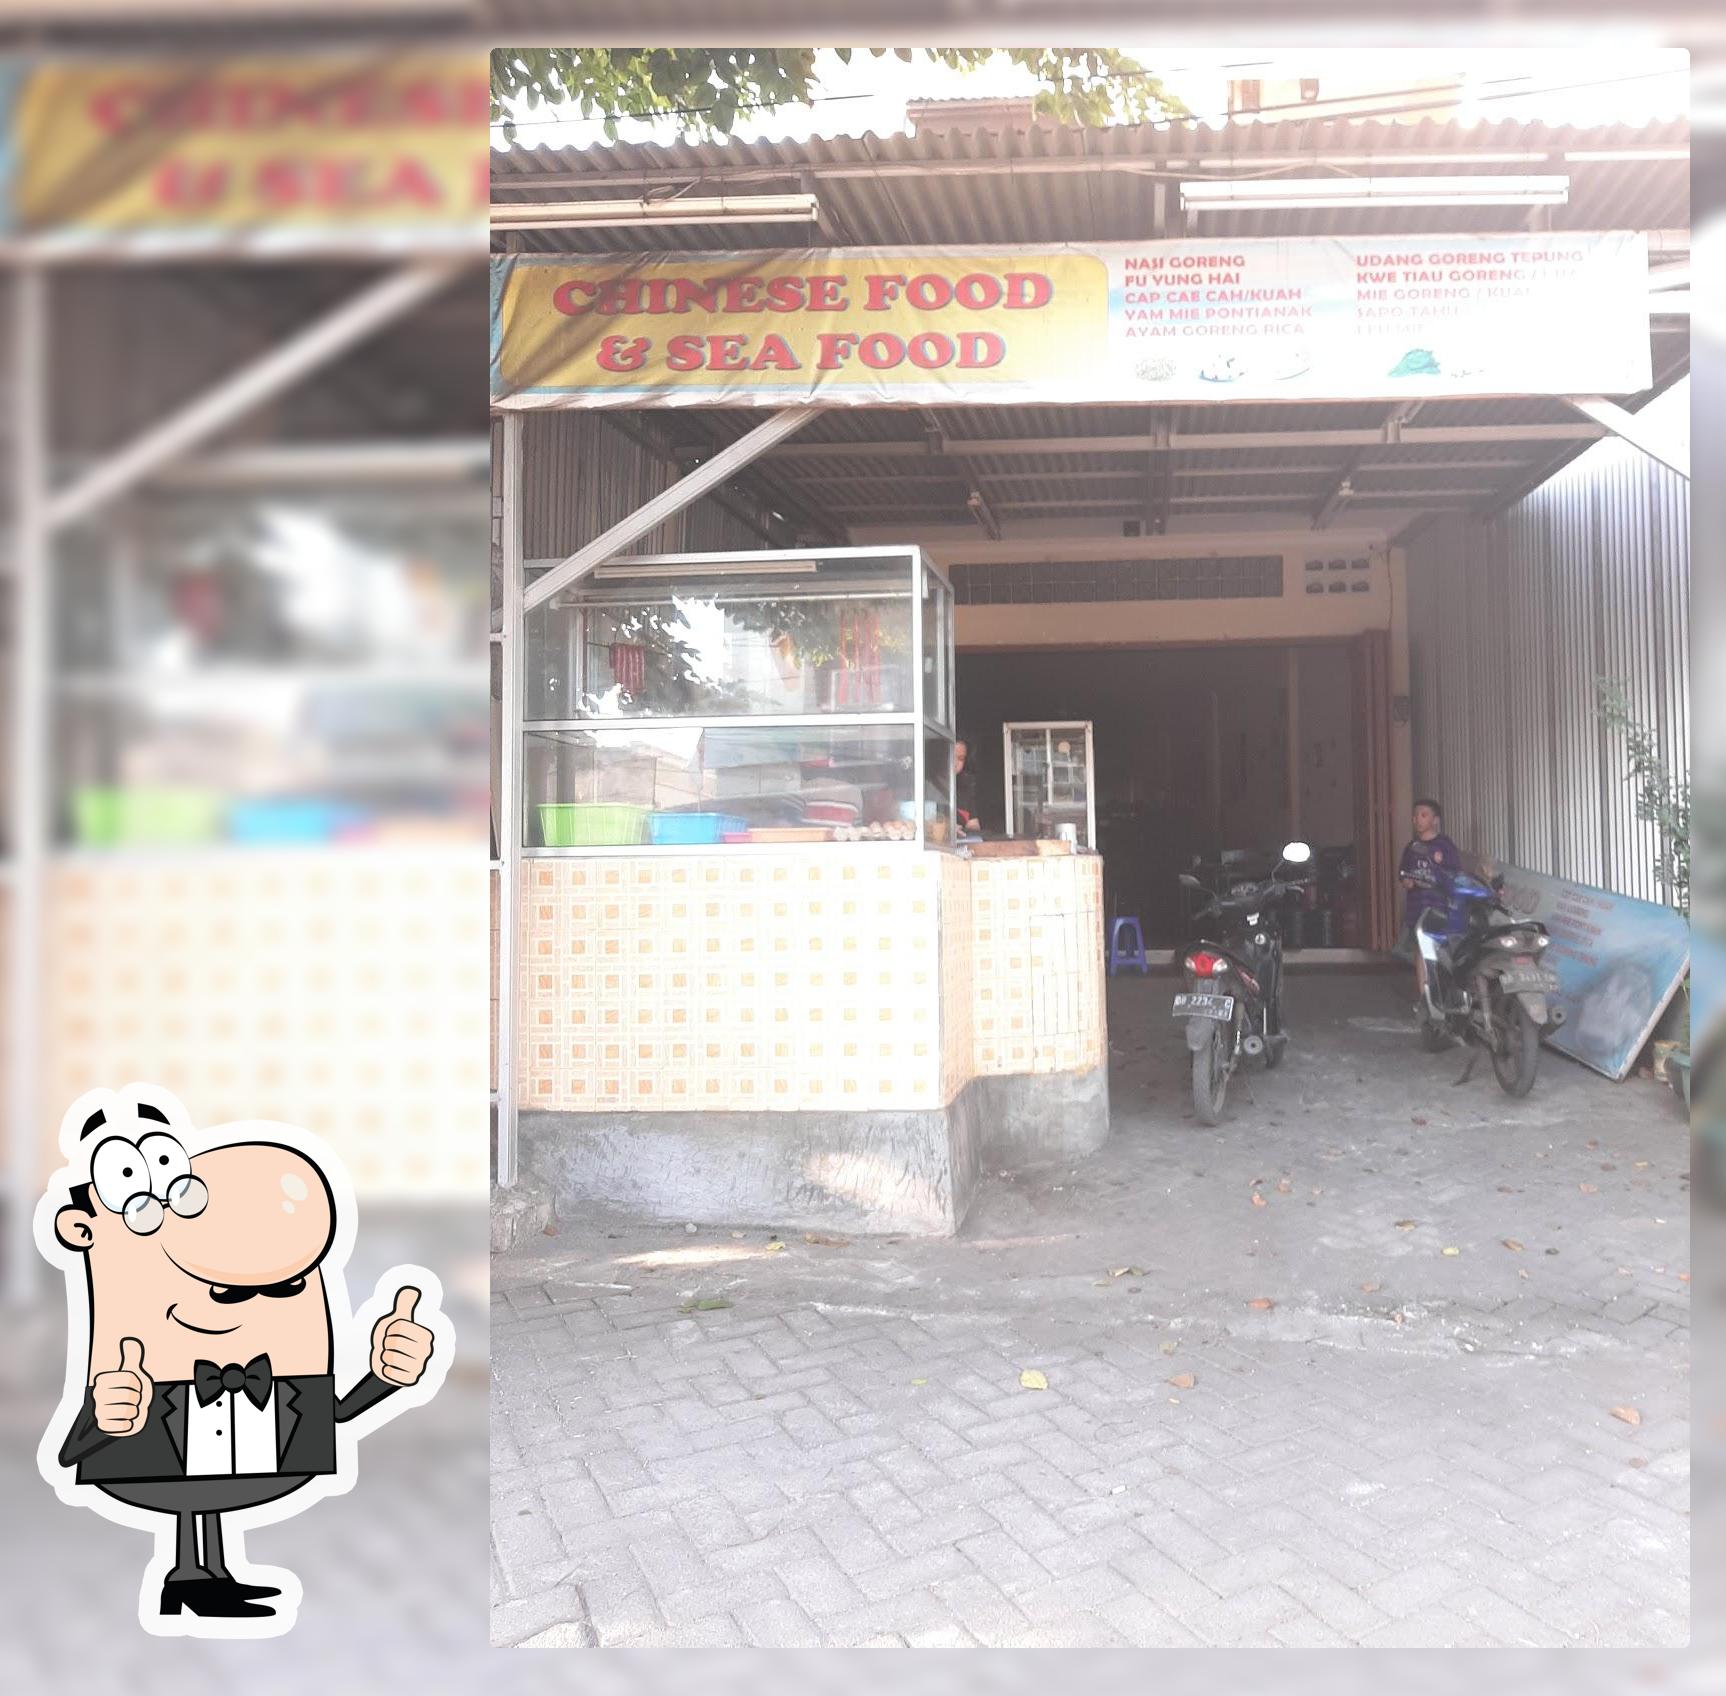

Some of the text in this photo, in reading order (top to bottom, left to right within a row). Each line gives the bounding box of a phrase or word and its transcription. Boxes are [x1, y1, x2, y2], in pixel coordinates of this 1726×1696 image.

[1169, 255, 1246, 268] GORENG
[1356, 250, 1584, 267] UDANG GORENG TEPUNG
[1125, 271, 1241, 287] FU YUNG HAI
[1356, 271, 1397, 284] KWE
[1402, 270, 1443, 283] TIAU
[1448, 268, 1526, 281] GORENG
[553, 271, 1055, 318] CHINESE FOOD
[1125, 291, 1161, 305] CAP
[1206, 288, 1302, 303] CAH/KUAH
[1356, 288, 1387, 301] MIE
[1393, 287, 1471, 300] GORENG
[1169, 307, 1200, 320] MIE
[1206, 305, 1312, 319] PONTIANAK
[1125, 322, 1305, 338] AYAM GORENG RICA
[595, 331, 1007, 374] & SEA FOOD
